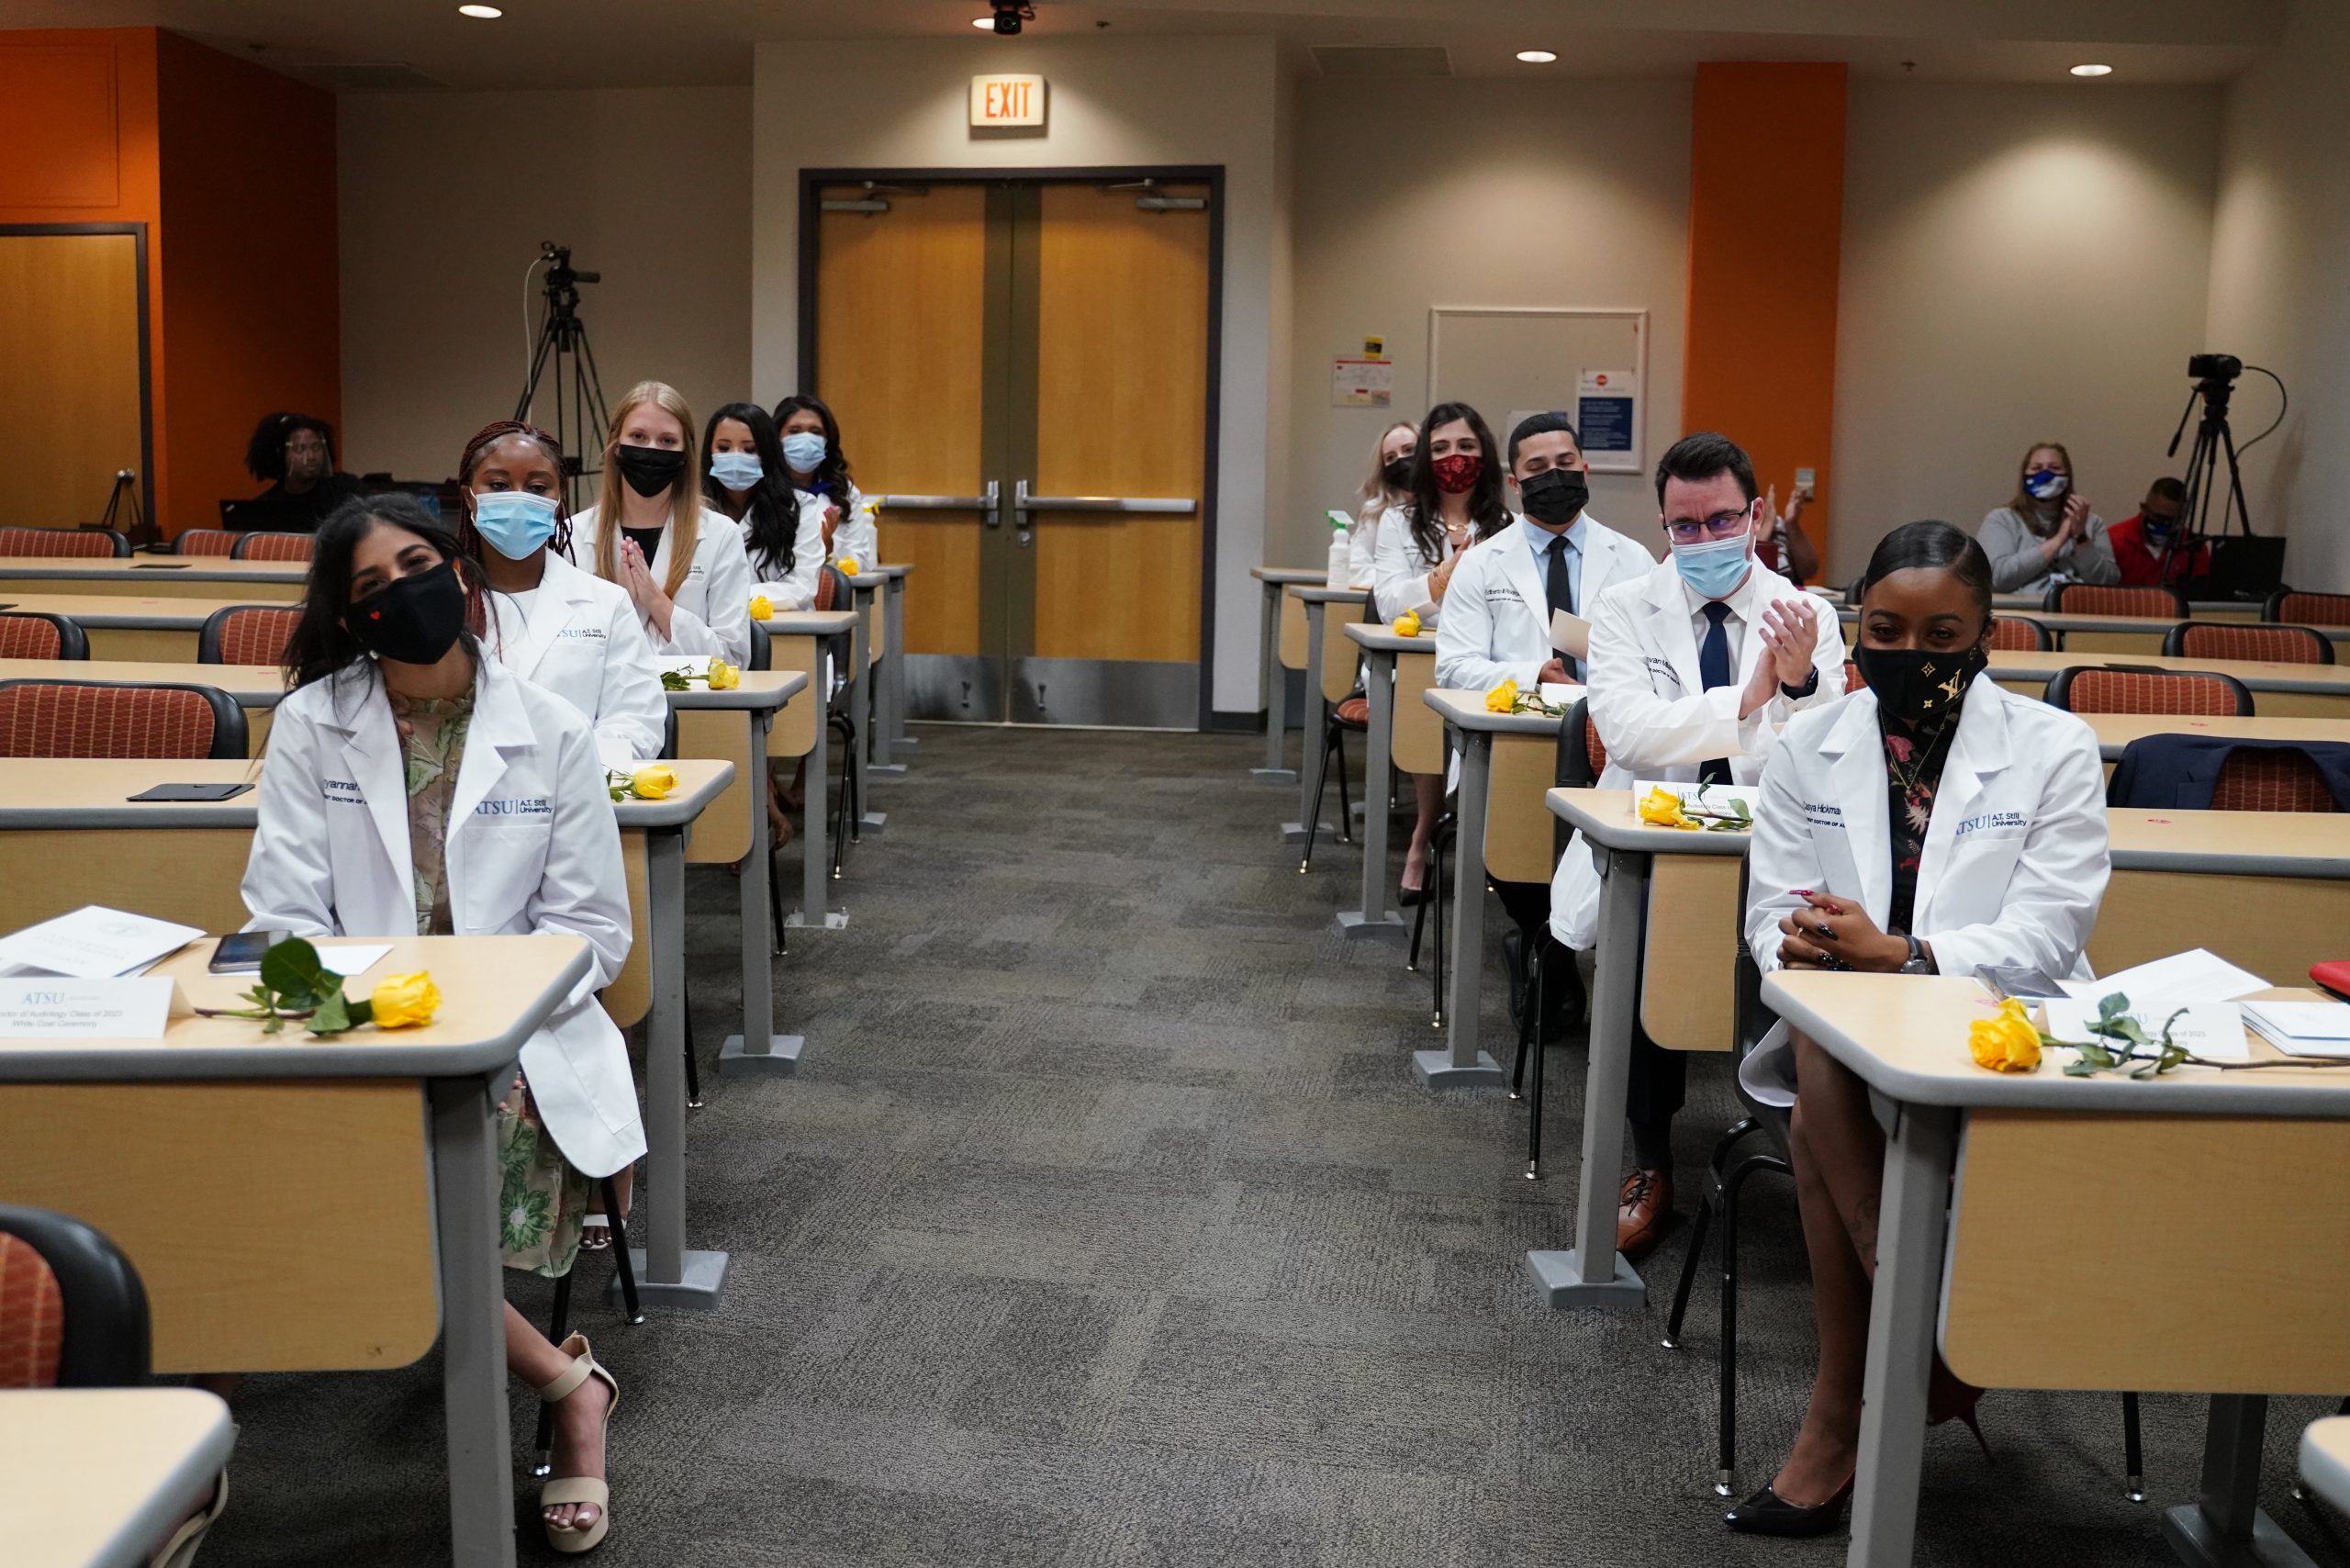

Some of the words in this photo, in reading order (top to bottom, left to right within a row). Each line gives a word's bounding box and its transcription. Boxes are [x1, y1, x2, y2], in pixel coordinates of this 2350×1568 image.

[985, 82, 1033, 118] EXIT
[331, 796, 354, 804] DOCTOR
[520, 806, 553, 814] University
[1992, 812, 2004, 821] A.T.
[1992, 819, 2027, 827] University
[23, 991, 65, 1005] ATSU
[30, 1010, 67, 1019] Audiology
[70, 1010, 91, 1018] Class
